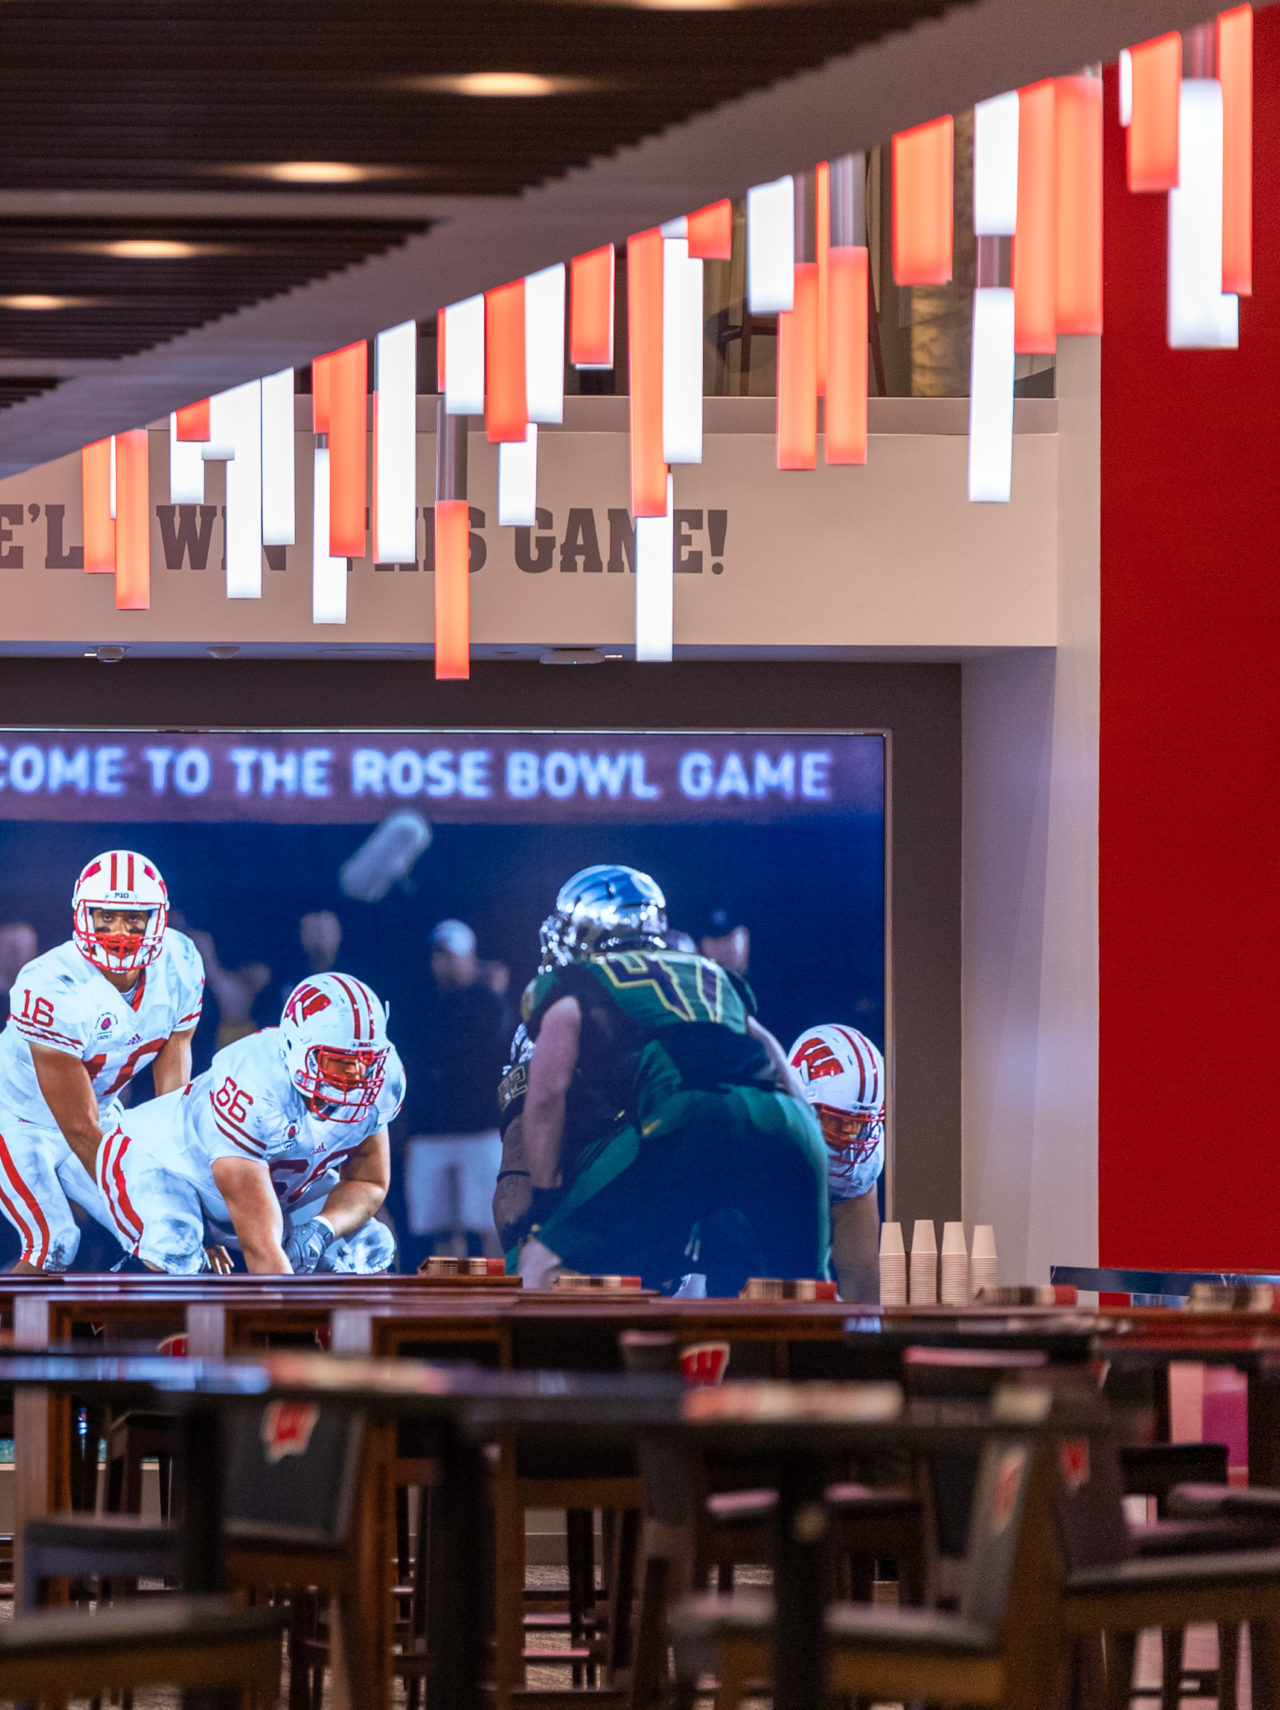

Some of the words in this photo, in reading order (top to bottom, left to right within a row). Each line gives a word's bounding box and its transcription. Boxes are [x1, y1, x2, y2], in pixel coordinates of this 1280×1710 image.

[145, 747, 212, 795] TO
[228, 747, 332, 797] THE
[350, 748, 492, 798] ROSE
[504, 749, 660, 799] BOWL
[677, 751, 834, 800] GAME
[21, 989, 55, 1027] 16
[216, 1076, 254, 1123] 66
